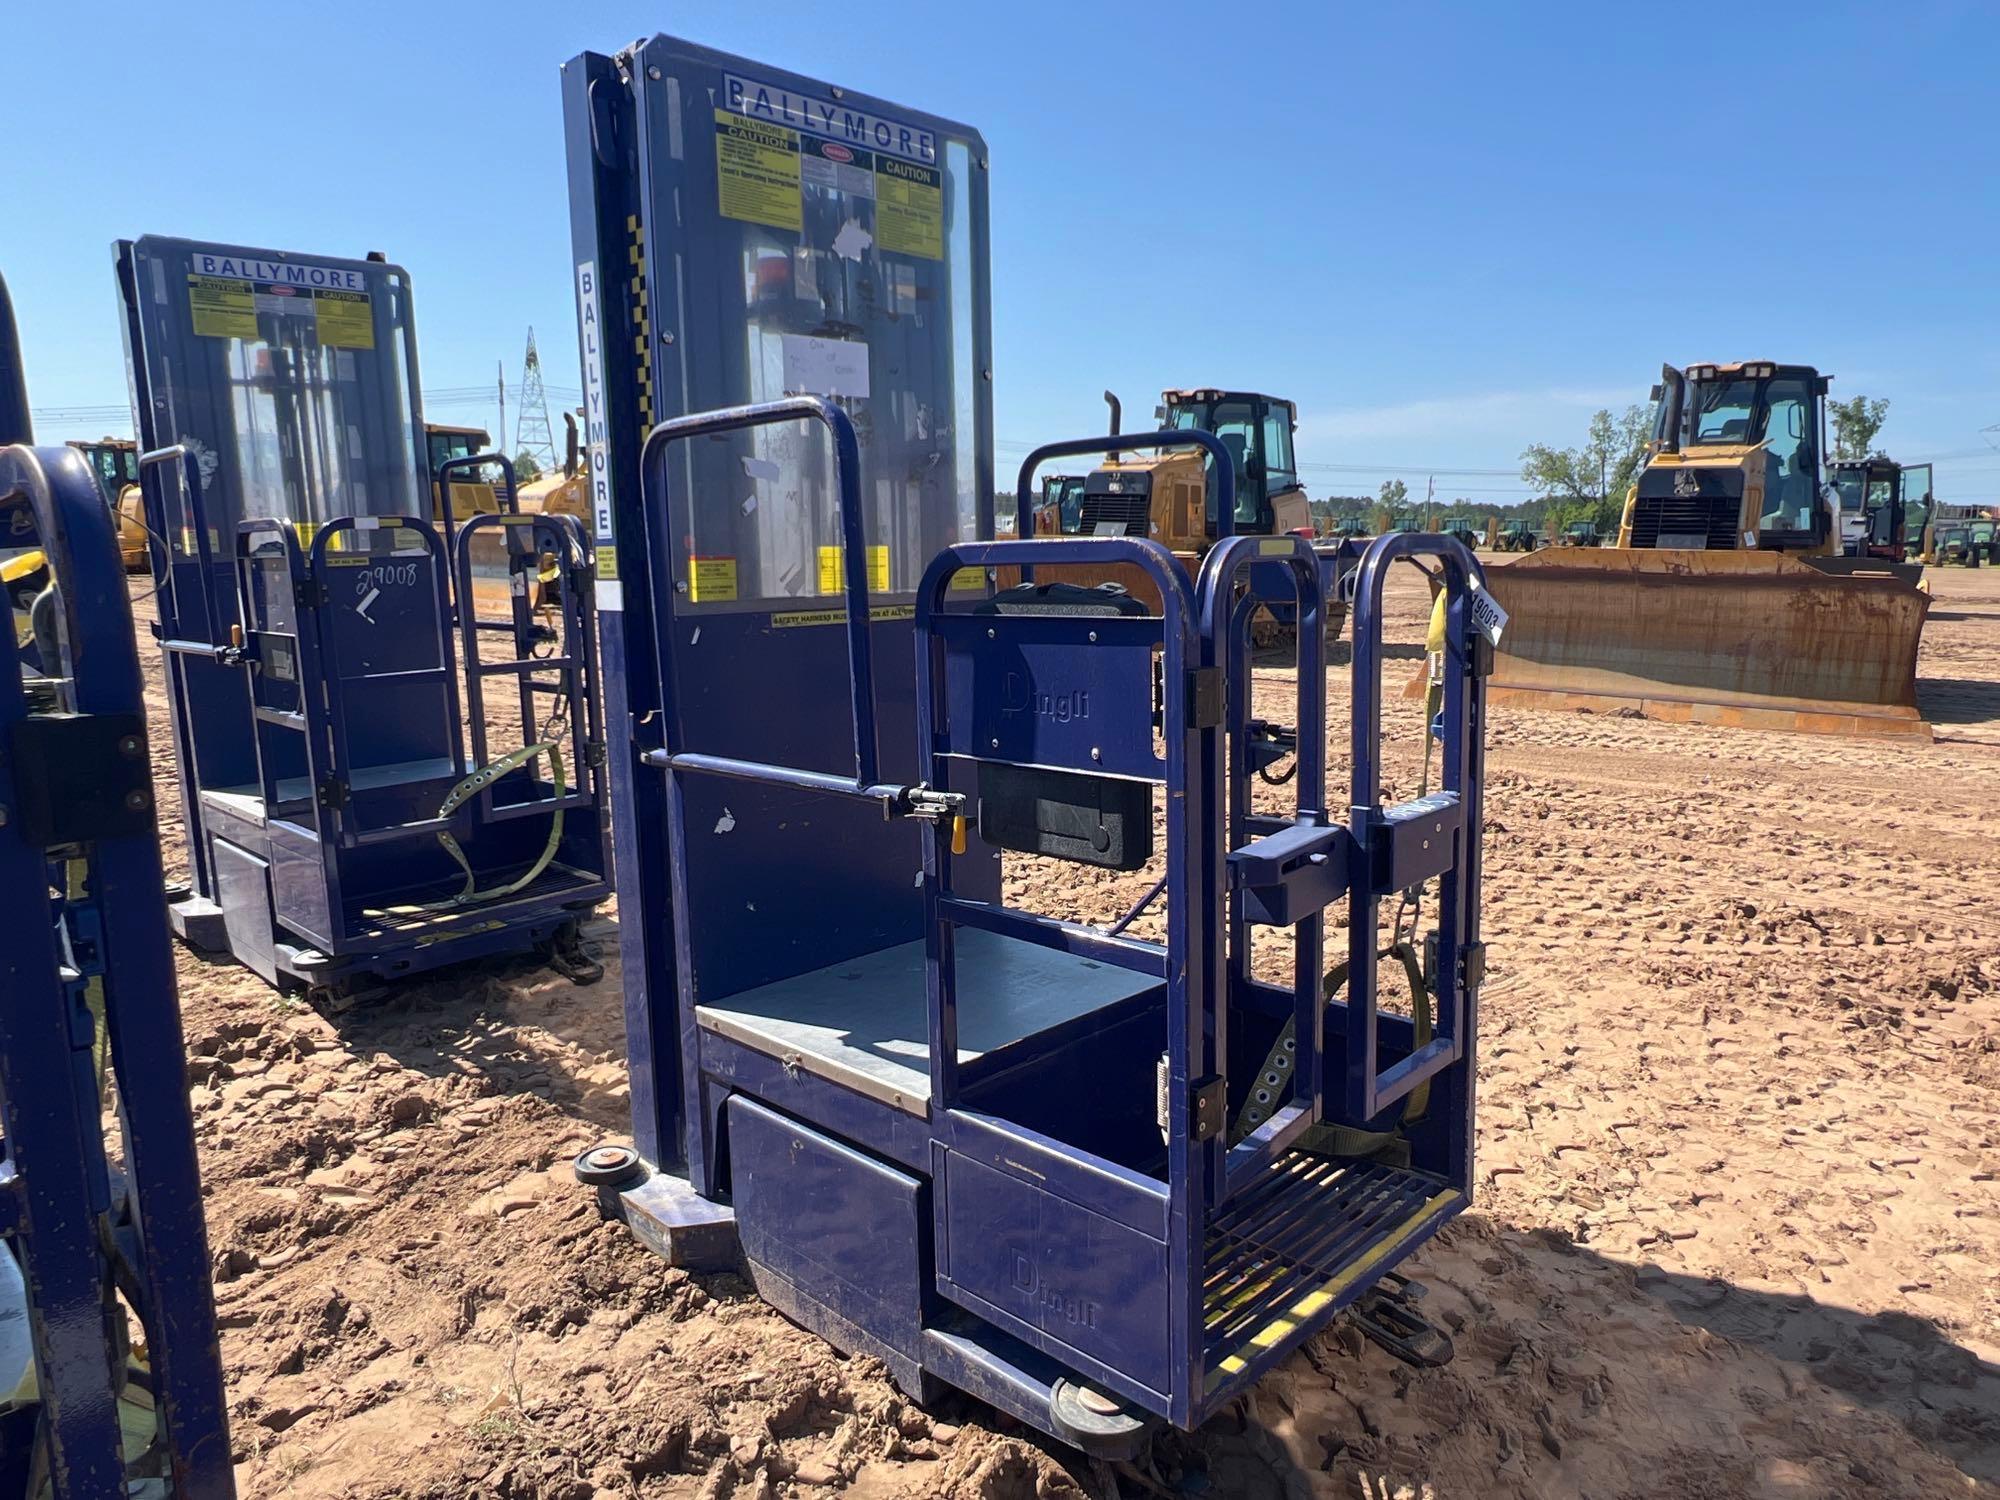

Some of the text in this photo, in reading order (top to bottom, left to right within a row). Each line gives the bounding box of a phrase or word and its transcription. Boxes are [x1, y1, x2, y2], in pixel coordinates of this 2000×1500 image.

[729, 79, 935, 160] BALLYMORE
[733, 117, 782, 137] BALLYMORE
[728, 127, 789, 150] CAUTION
[886, 161, 931, 183] CAUTION
[203, 257, 357, 289] BALLYMORE
[322, 291, 362, 302] CAUTION
[582, 272, 609, 530] BALLYMORE
[356, 563, 419, 596] 219008
[773, 615, 800, 625] SAFETY
[800, 613, 832, 623] HARNESS
[882, 610, 891, 618] AT
[891, 608, 903, 617] ALL
[1002, 671, 1091, 724] Dingli
[1010, 1247, 1101, 1330] Dingli
